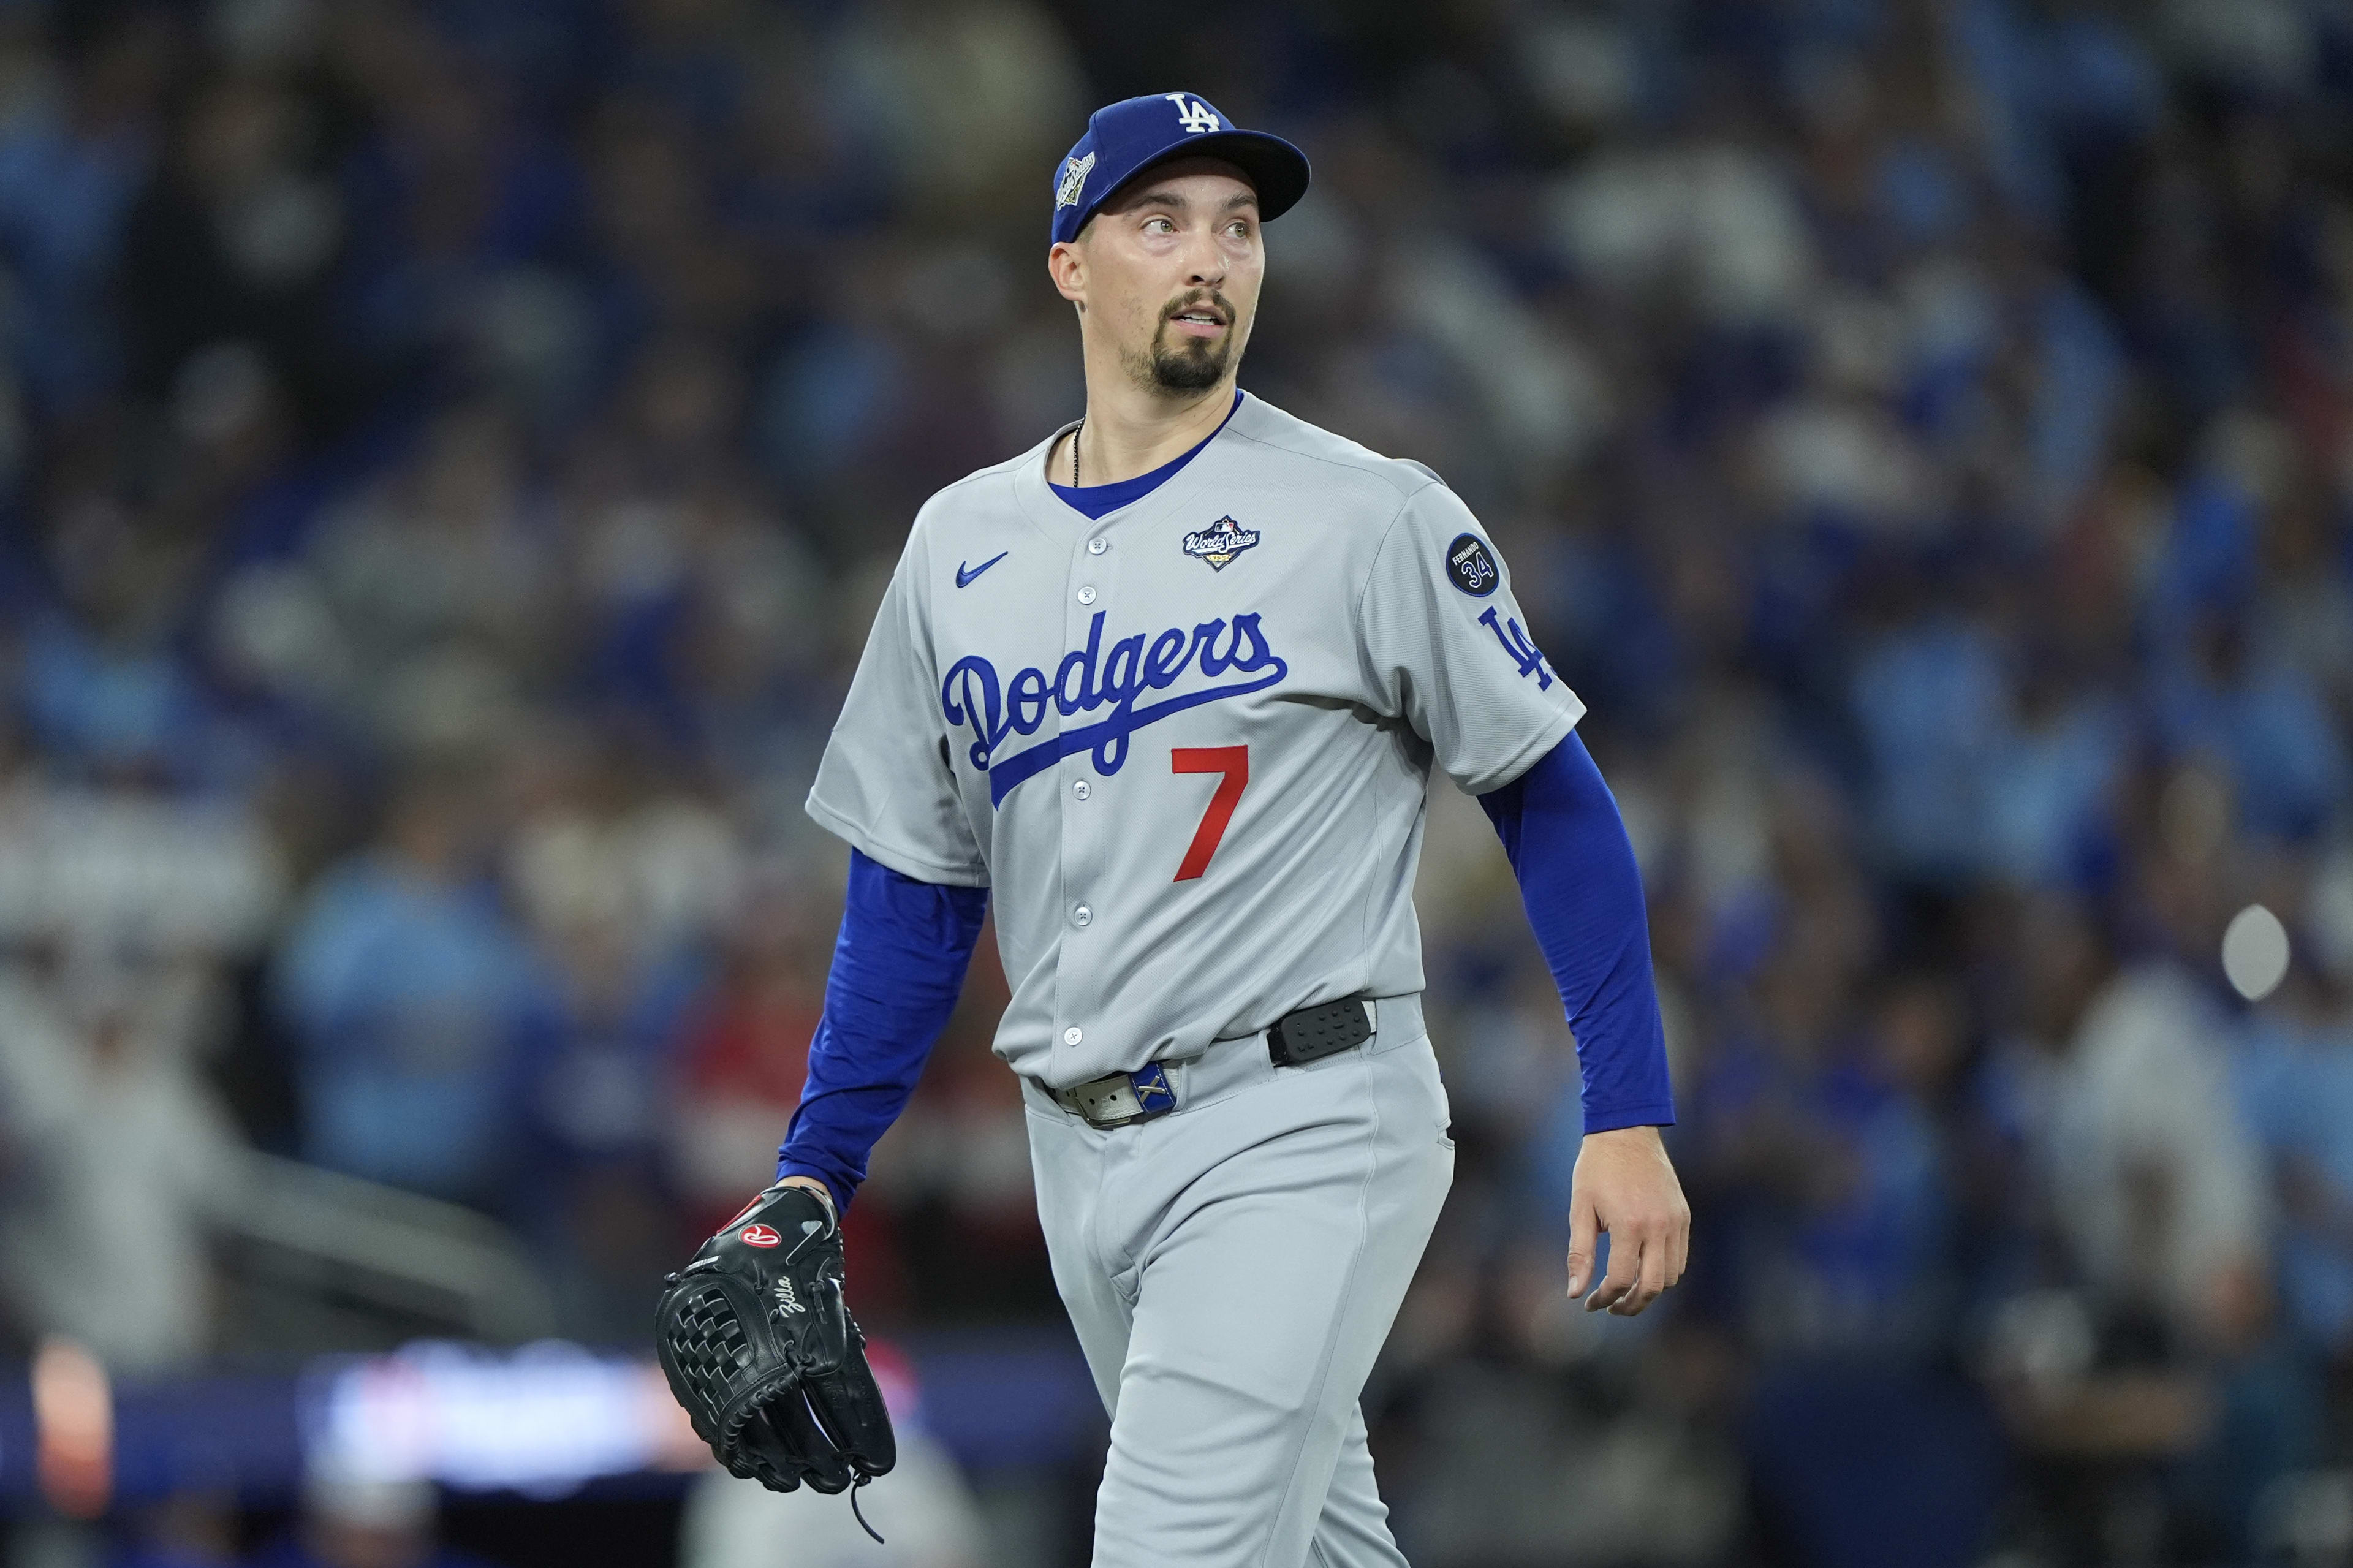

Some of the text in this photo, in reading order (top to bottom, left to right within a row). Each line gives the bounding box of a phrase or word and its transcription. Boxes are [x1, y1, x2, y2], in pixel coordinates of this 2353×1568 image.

[1165, 94, 1220, 132] LA
[1186, 532, 1256, 553] World Series
[1452, 542, 1479, 566] FERNANDO
[1461, 551, 1494, 588] 34
[1477, 605, 1557, 692] LA
[942, 610, 1287, 776] Dodgers
[1171, 745, 1249, 882] 7
[773, 1276, 806, 1317] Zilla
